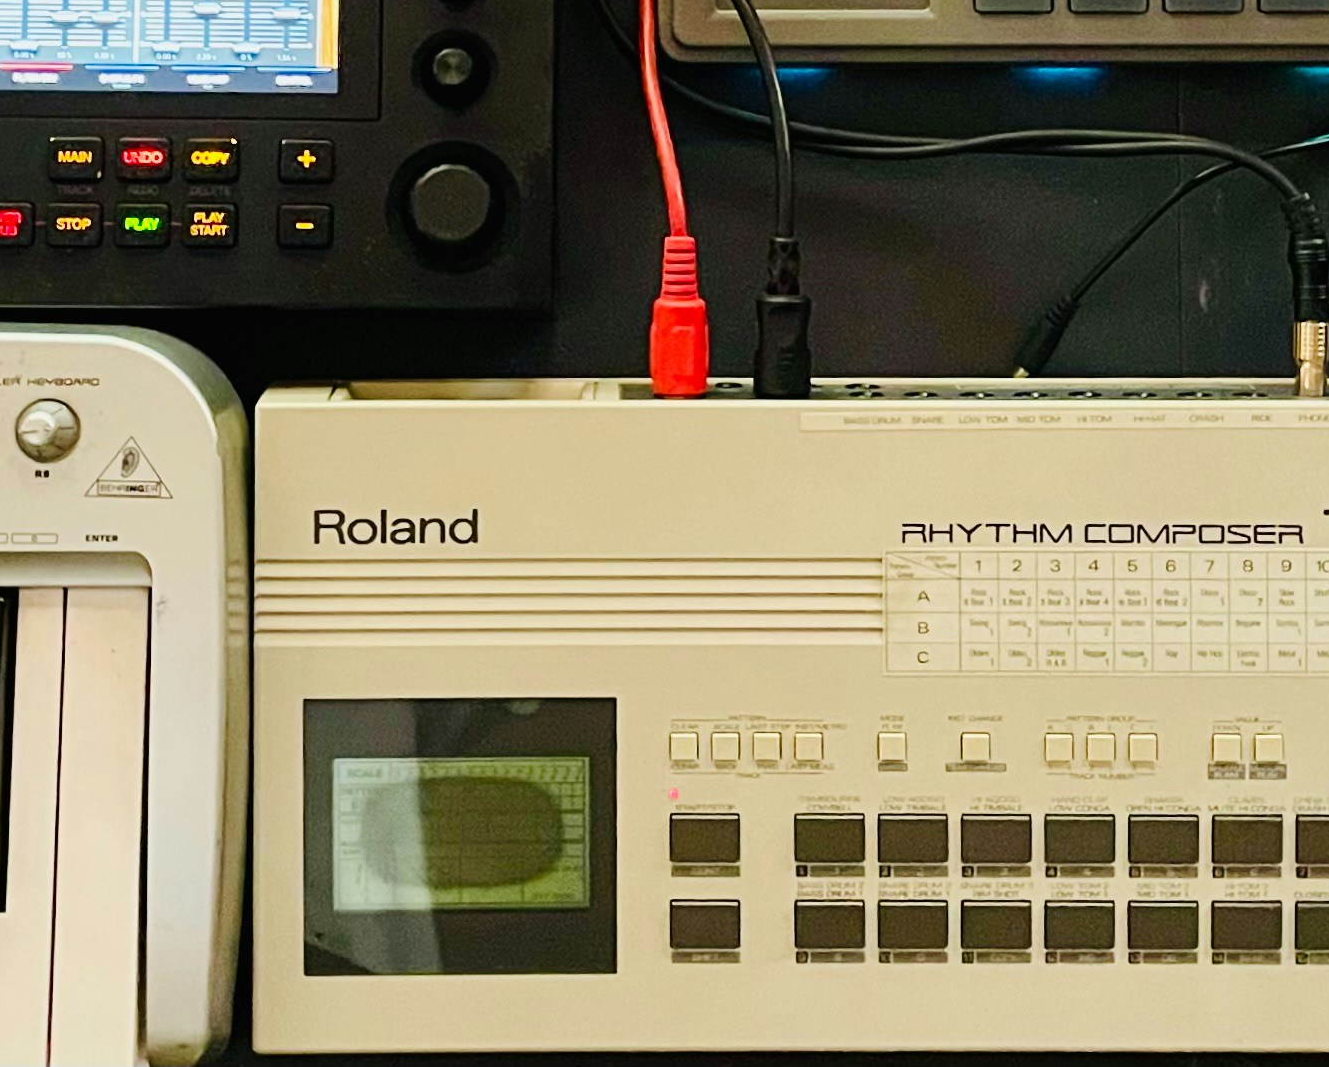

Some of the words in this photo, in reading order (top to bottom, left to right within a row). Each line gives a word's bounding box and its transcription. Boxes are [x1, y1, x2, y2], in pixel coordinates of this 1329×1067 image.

[56, 150, 93, 164] MAIN
[122, 150, 164, 164] UNDO
[190, 150, 230, 166] COPY
[56, 217, 92, 231] STOP
[125, 217, 161, 232] PLAY
[193, 212, 225, 225] PLAY
[189, 224, 228, 238] START
[99, 483, 160, 494] BEHRINGER
[312, 507, 479, 545] Roland
[85, 534, 119, 543] ENTER
[901, 523, 1073, 545] RHYTHM
[1083, 523, 1304, 545] COMPOSER
[974, 559, 983, 574] 1
[1012, 559, 1024, 574] 2
[1050, 559, 1062, 574] 3
[1088, 559, 1101, 574] 4
[1127, 559, 1139, 574] 5
[1165, 559, 1178, 574] 6
[1204, 559, 1216, 574] 7
[1242, 559, 1255, 574] 8
[1281, 559, 1293, 574] 9
[916, 590, 931, 603] A
[916, 621, 930, 634] B
[916, 650, 930, 664] C
